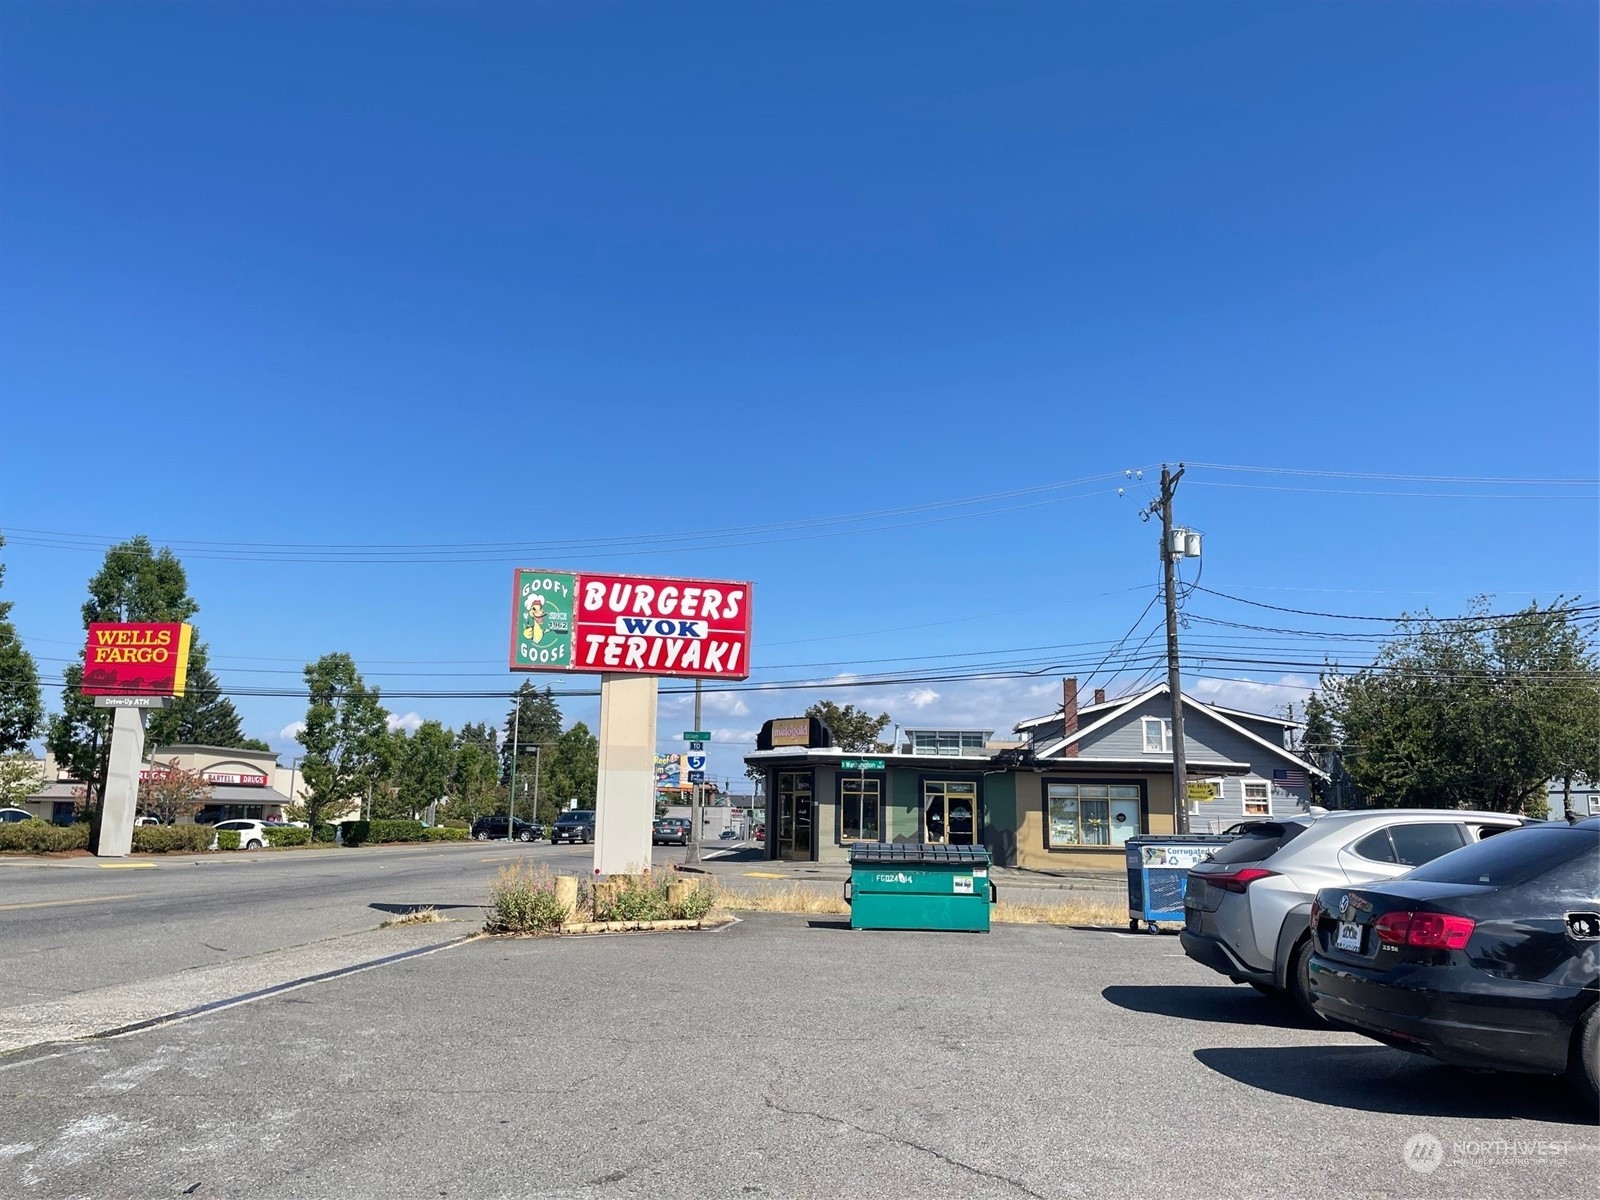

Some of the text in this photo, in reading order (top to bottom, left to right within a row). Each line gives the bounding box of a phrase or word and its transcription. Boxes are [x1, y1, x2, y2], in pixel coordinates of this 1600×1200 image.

[522, 578, 568, 598] GOOFY
[583, 581, 744, 620] BURGERS
[548, 621, 568, 629] 1962
[622, 618, 701, 637] WOK
[95, 630, 171, 646] WELLS
[94, 647, 169, 663] FARGO
[520, 642, 565, 663] GOOSE
[585, 634, 742, 672] TERIYAKI
[105, 698, 150, 706] Drive-Up ATM
[773, 725, 808, 739] melogold
[692, 756, 701, 768] 5
[243, 775, 264, 784] DRUGS
[1167, 847, 1211, 856] Corrugated
